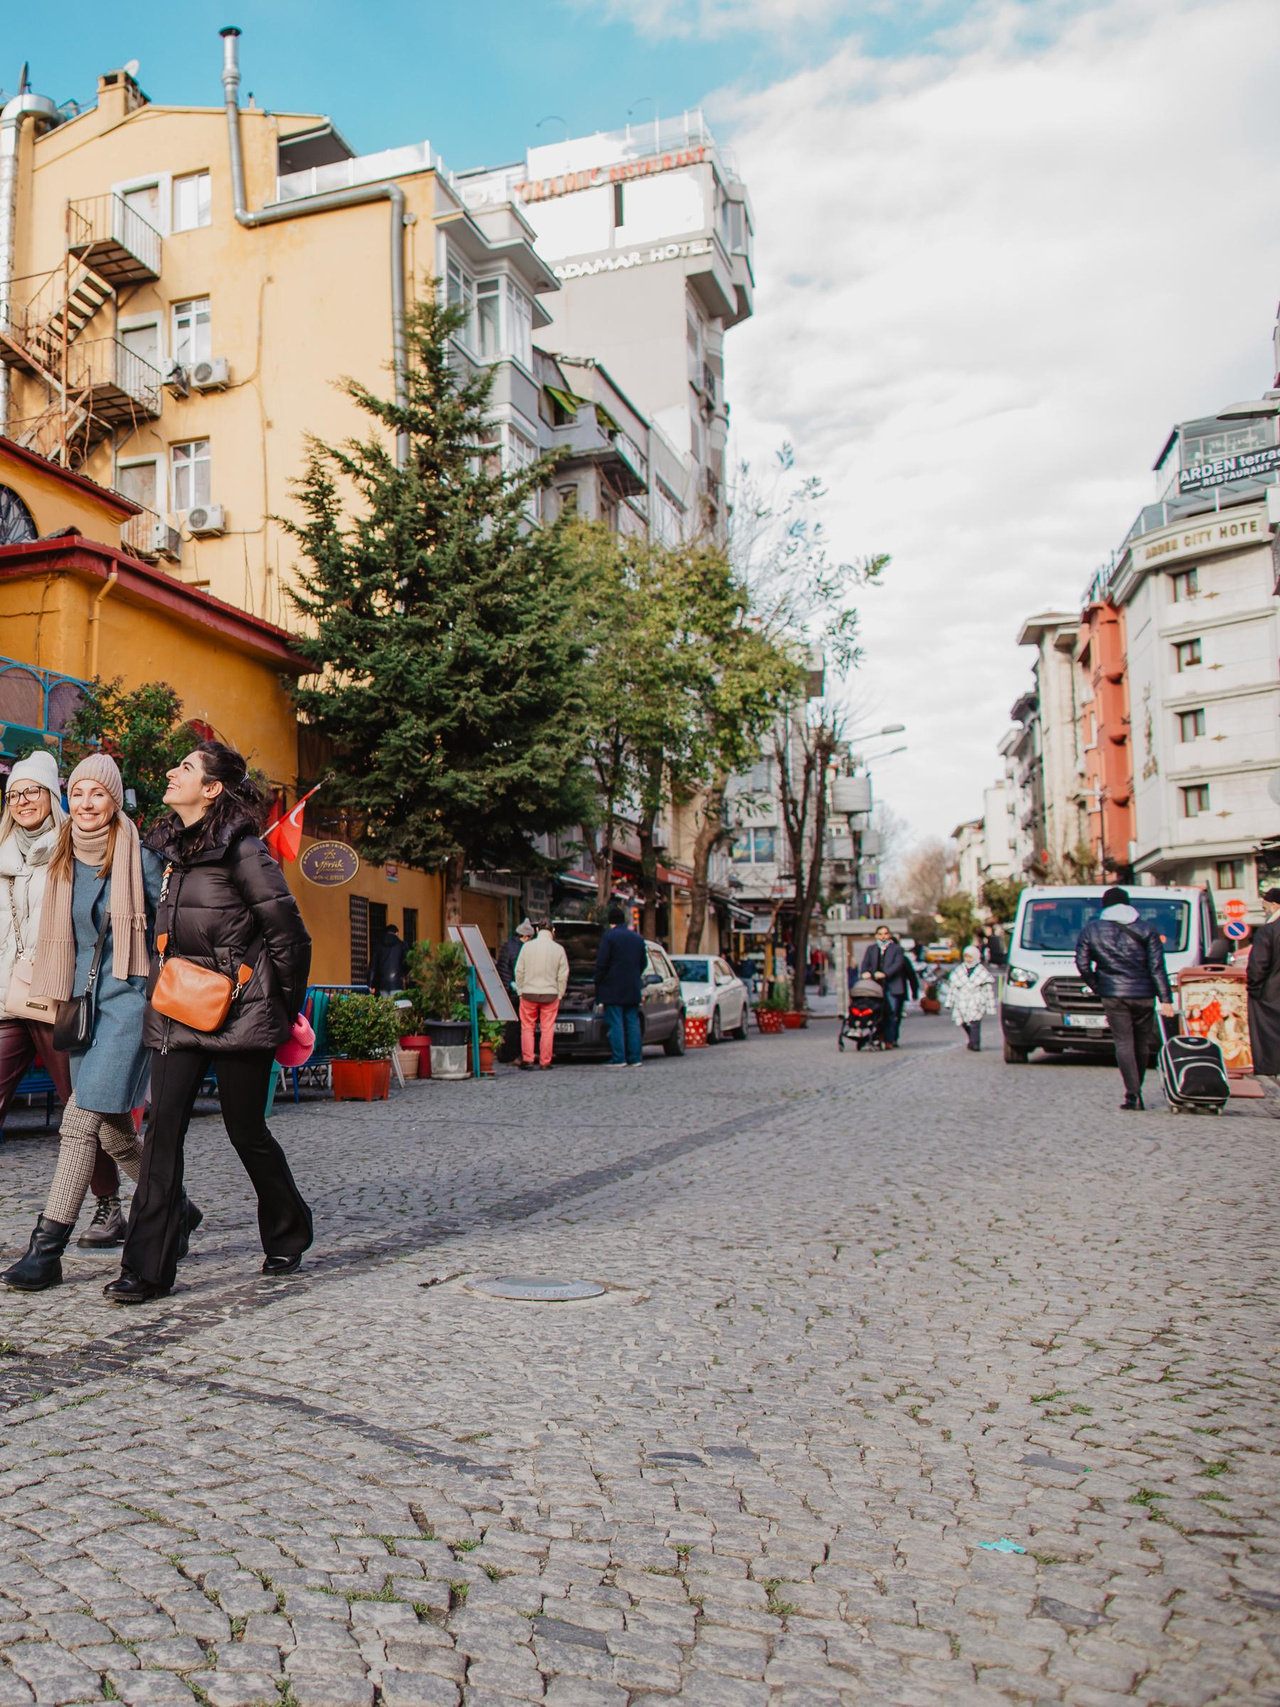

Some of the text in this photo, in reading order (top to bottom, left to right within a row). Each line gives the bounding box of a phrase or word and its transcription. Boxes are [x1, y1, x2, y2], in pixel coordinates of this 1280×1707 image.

[609, 147, 706, 181] RESTAURANT
[553, 238, 714, 280] ADAMAR HOTEL
[1179, 458, 1236, 484] ARDEN
[1202, 462, 1272, 487] RESTAURANT
[1184, 529, 1212, 547] CITY
[1219, 520, 1262, 538] HOTE
